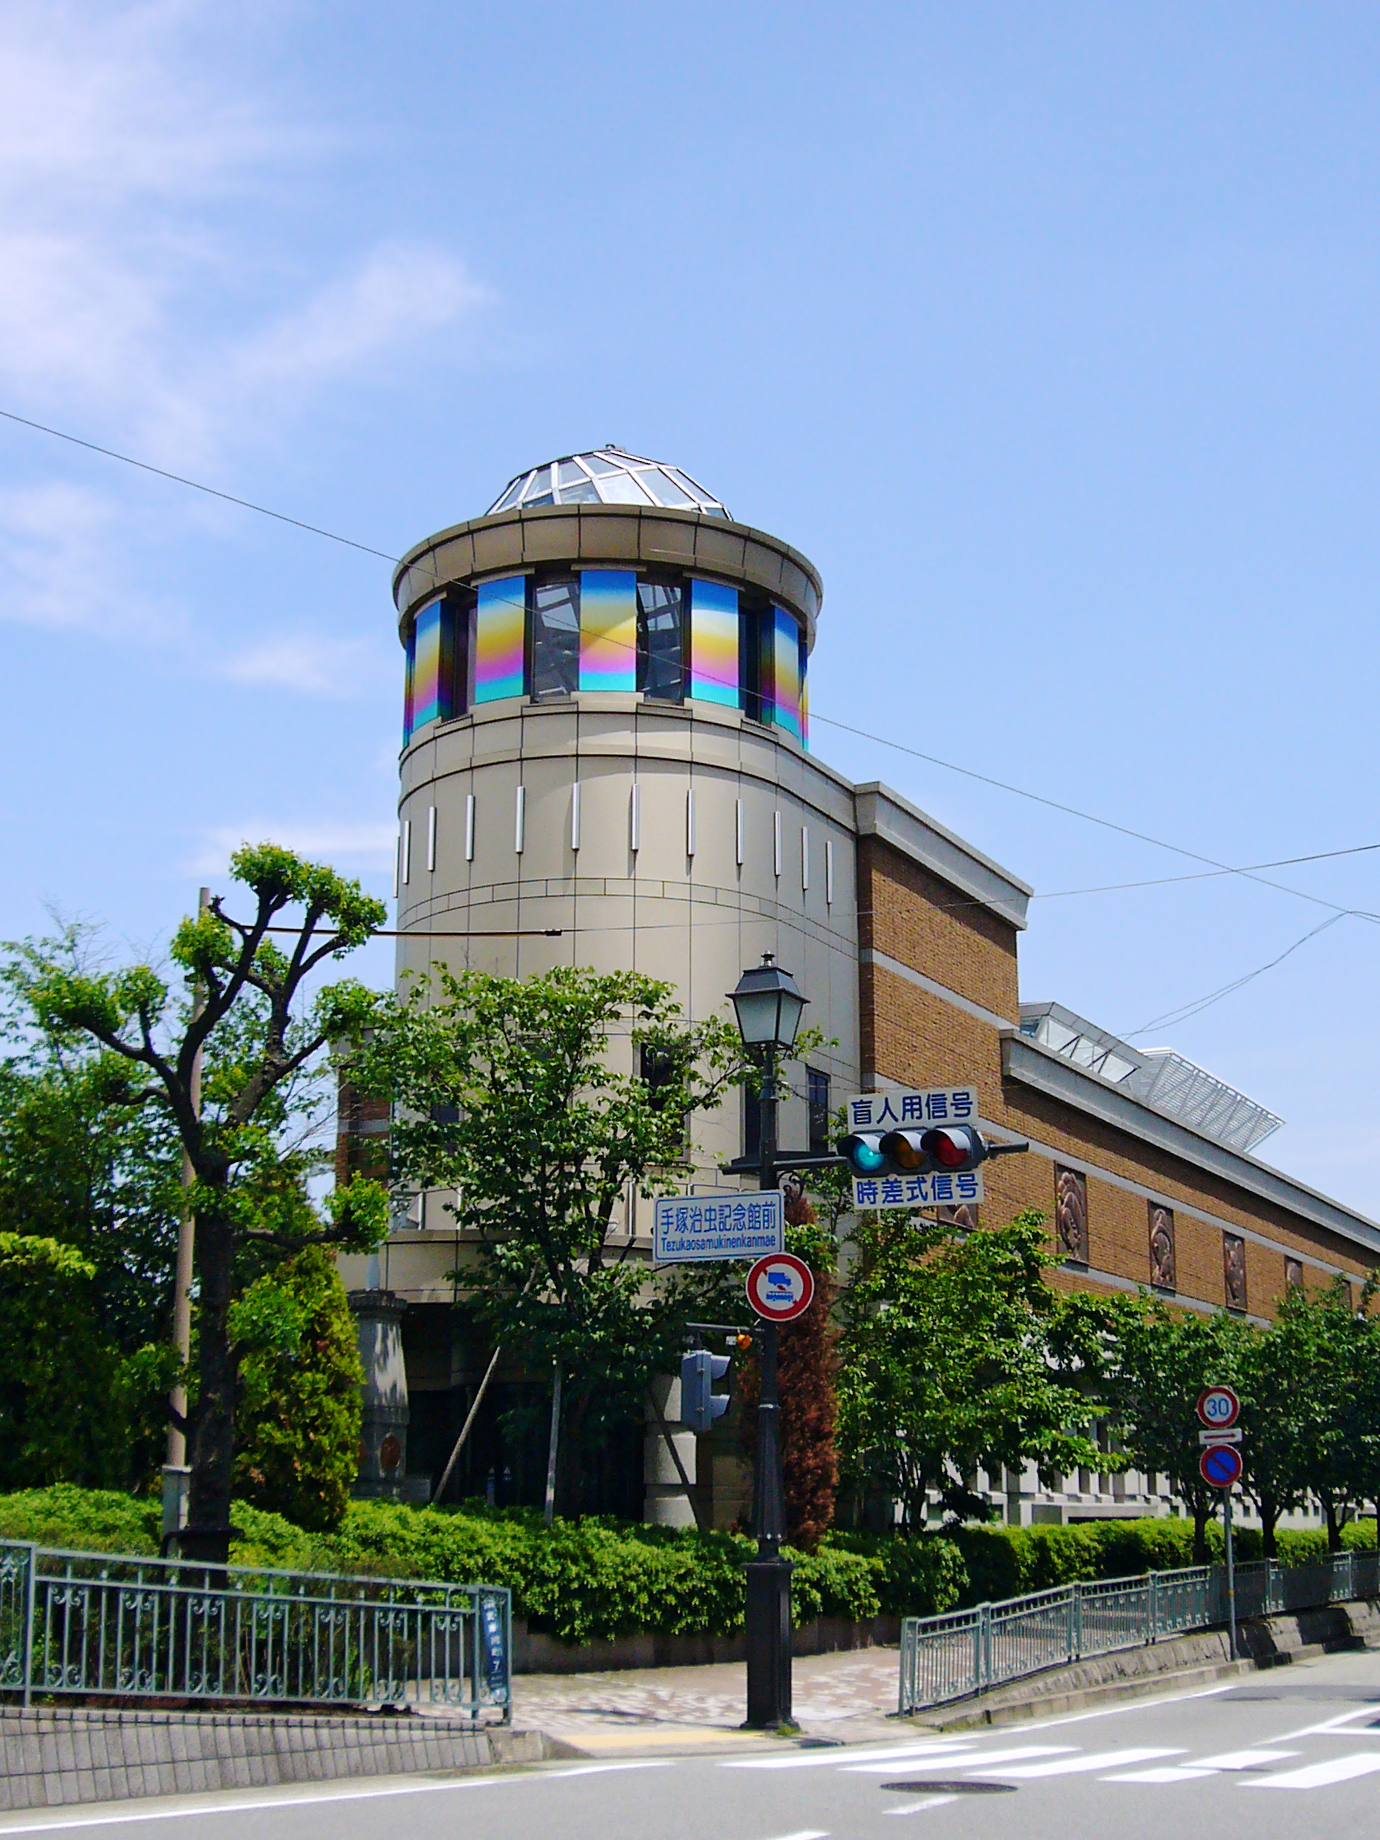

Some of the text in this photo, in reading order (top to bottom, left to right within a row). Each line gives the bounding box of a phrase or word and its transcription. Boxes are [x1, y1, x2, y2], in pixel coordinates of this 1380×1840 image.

[851, 1091, 973, 1125] 盲人用信号
[856, 1173, 979, 1205] 時差式信号
[660, 1201, 776, 1235] 手塚治虫記念館前
[660, 1234, 776, 1252] Tezukaosamukinenkanmae
[1206, 1398, 1230, 1417] 30
